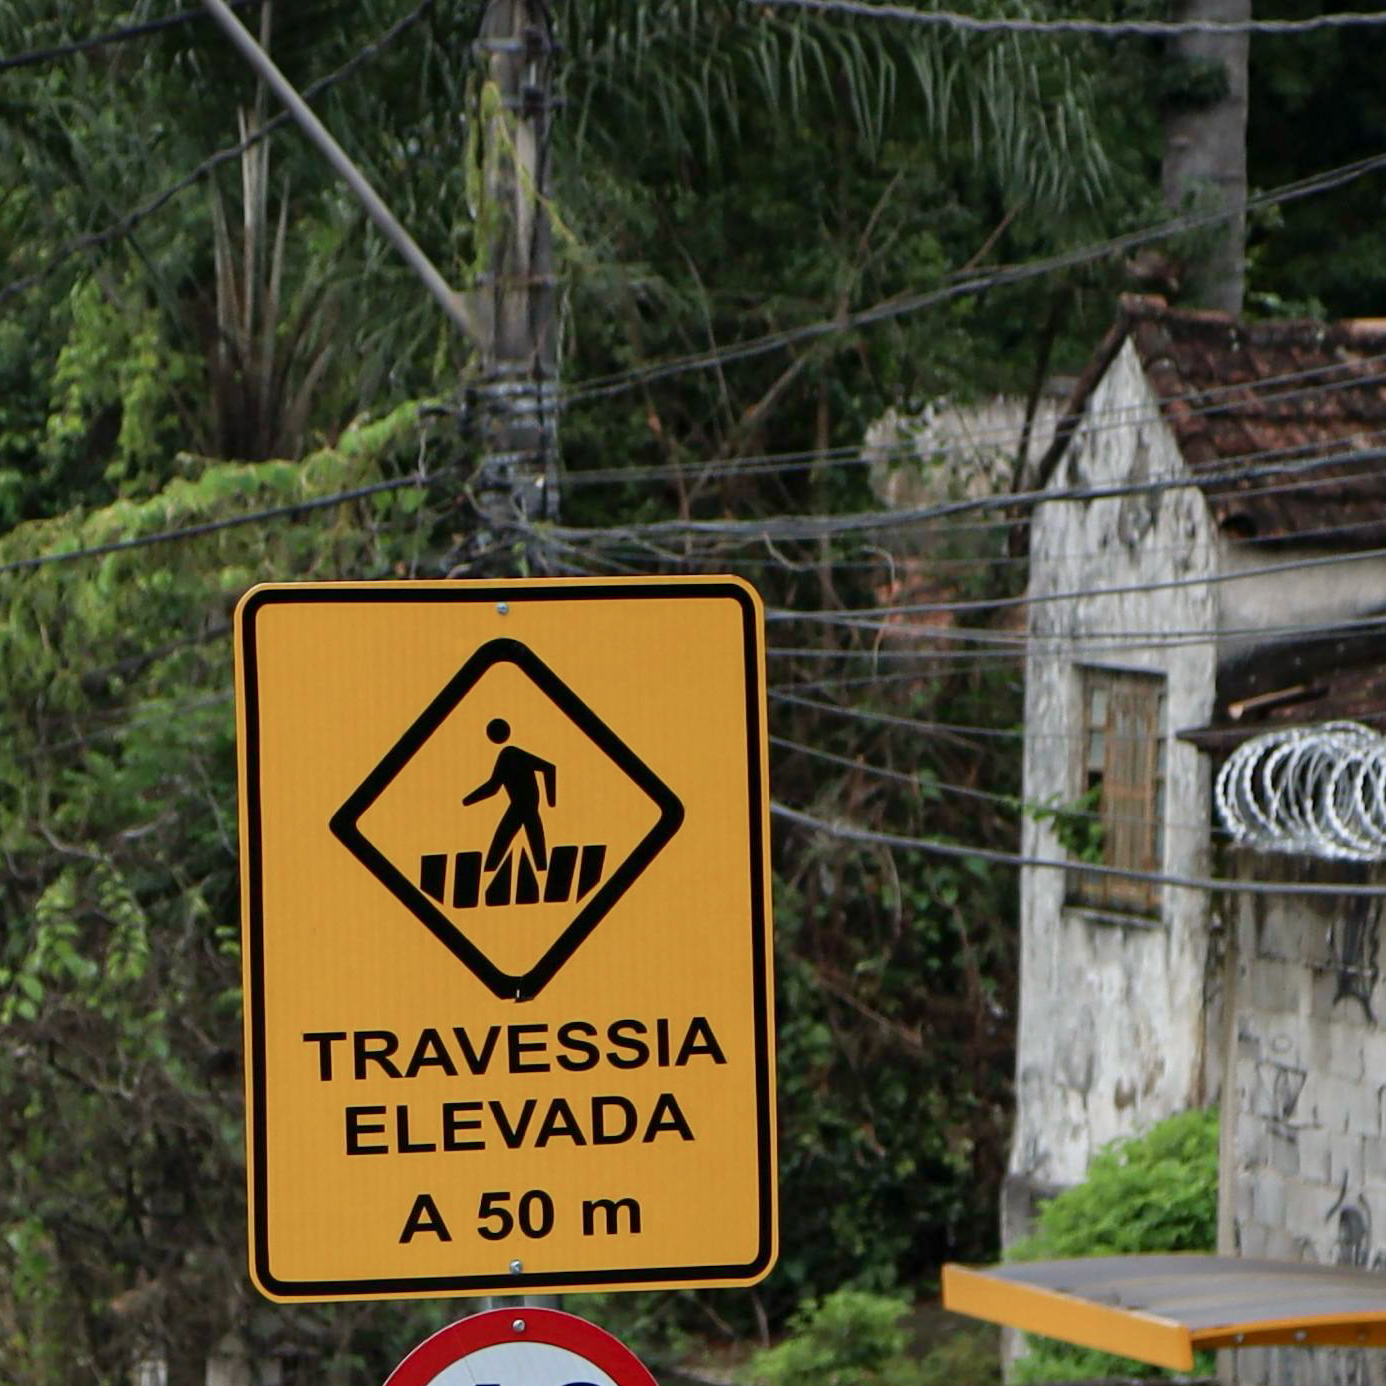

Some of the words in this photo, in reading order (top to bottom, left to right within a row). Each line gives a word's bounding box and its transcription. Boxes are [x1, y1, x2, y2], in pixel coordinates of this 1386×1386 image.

[302, 1016, 728, 1082] TRAVESSIA
[344, 1092, 696, 1156] ELEVADA
[398, 1193, 453, 1244] A
[476, 1189, 556, 1240] 50
[581, 1196, 643, 1236] m
